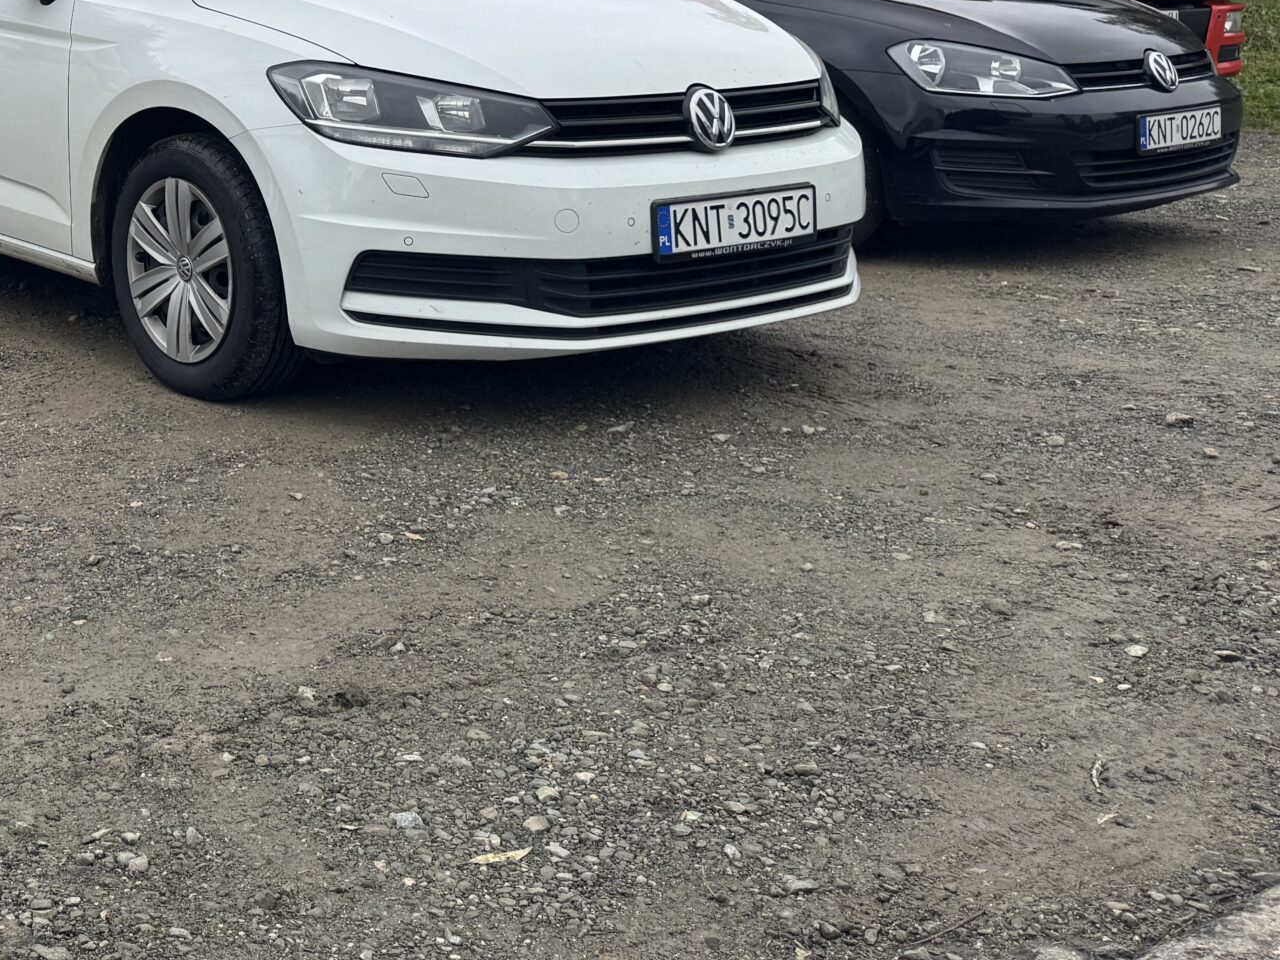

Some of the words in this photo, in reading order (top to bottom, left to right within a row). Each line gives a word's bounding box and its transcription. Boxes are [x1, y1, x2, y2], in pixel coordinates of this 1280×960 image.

[1148, 117, 1175, 146] KNT
[1180, 110, 1219, 141] 0262C
[672, 204, 725, 248] KNT
[736, 194, 810, 239] 3095C
[659, 235, 670, 246] PL
